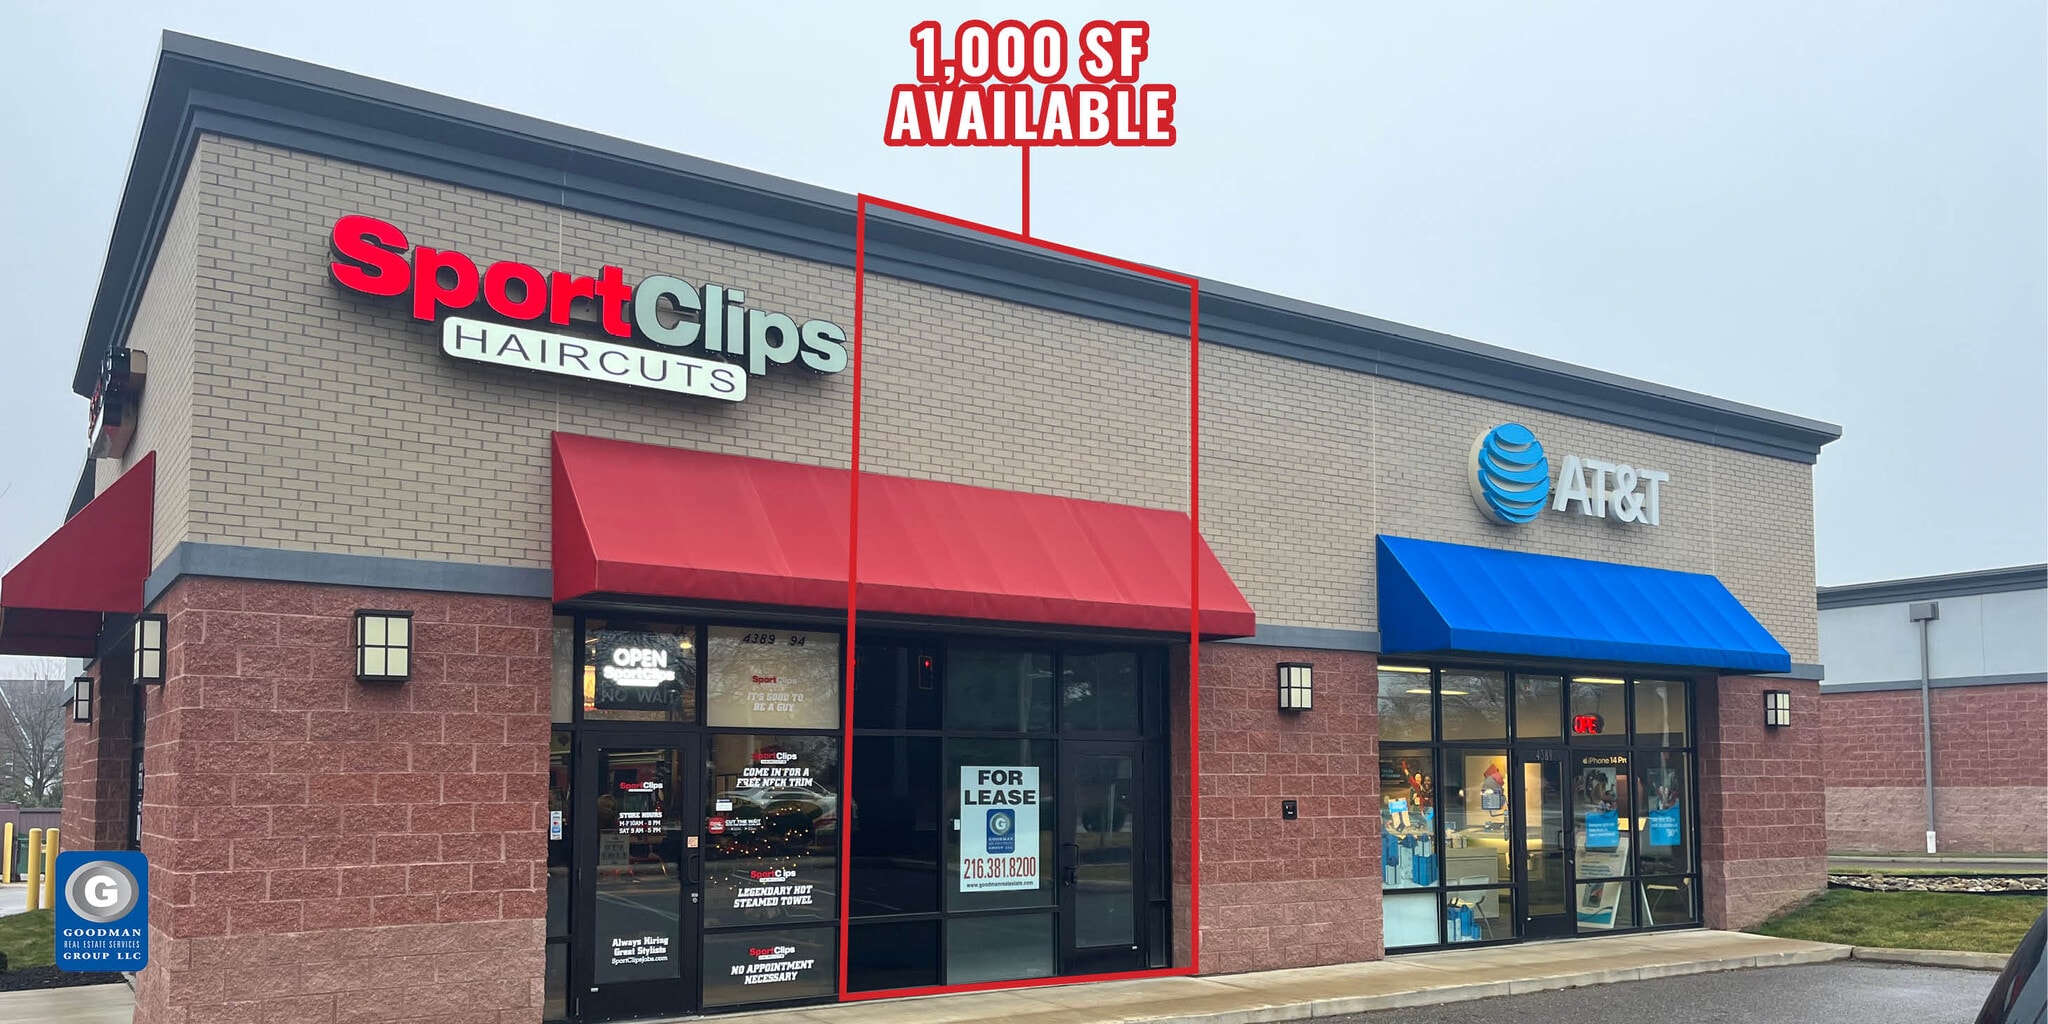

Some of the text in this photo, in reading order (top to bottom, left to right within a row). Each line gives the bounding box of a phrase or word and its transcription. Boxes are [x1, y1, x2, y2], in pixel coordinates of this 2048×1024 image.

[329, 214, 849, 377] SportClips
[455, 324, 736, 393] HAIRCUTS
[1551, 454, 1670, 526] AT&T
[742, 632, 806, 648] 4389 94
[613, 647, 668, 669] OPEN
[602, 687, 627, 702] NO
[766, 692, 790, 702] GOOD
[791, 693, 804, 702] TO
[752, 702, 796, 712] BE A GUY
[1536, 749, 1553, 761] 4389
[1588, 756, 1610, 765] iPhone
[1610, 755, 1618, 764] 14
[743, 767, 810, 777] COME IN FOR A
[978, 769, 1023, 786] FOR
[619, 781, 664, 791] SportClips
[736, 777, 813, 788] FREE NECK TRIM
[964, 789, 1037, 806] LEASE
[641, 811, 663, 819] HOURS
[750, 869, 796, 879] SportCips
[963, 857, 1037, 879] 216.381.8200
[737, 885, 813, 898] LEGENDARY HOT
[733, 895, 813, 909] STEAMED TOWEL
[612, 936, 669, 948] Always Hiring
[614, 945, 667, 957] Great Stylists
[749, 946, 796, 956] SportClips
[730, 959, 815, 975] NO APPOINTMENT
[744, 971, 798, 985] NECESSARY
